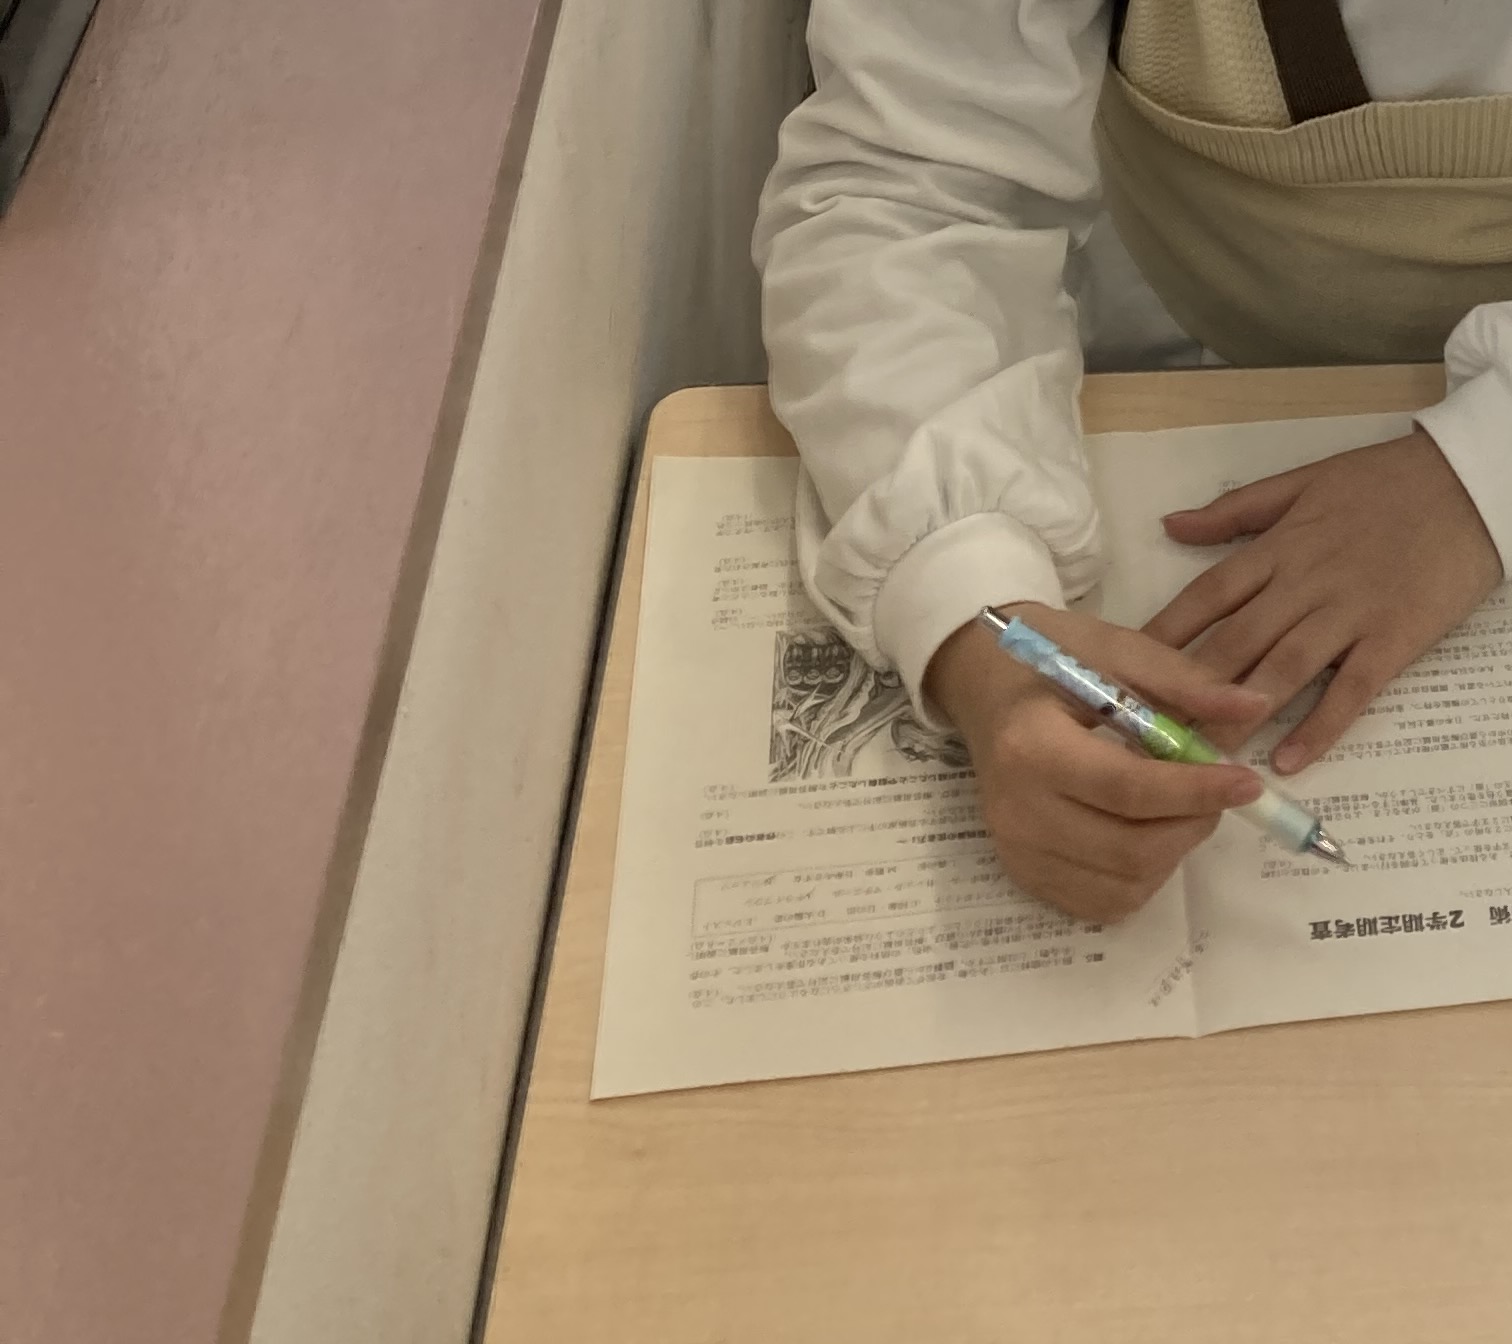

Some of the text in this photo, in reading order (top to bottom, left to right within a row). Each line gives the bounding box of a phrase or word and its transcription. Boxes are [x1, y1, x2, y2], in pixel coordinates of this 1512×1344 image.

[1308, 909, 1465, 941] 2学期定期考査
